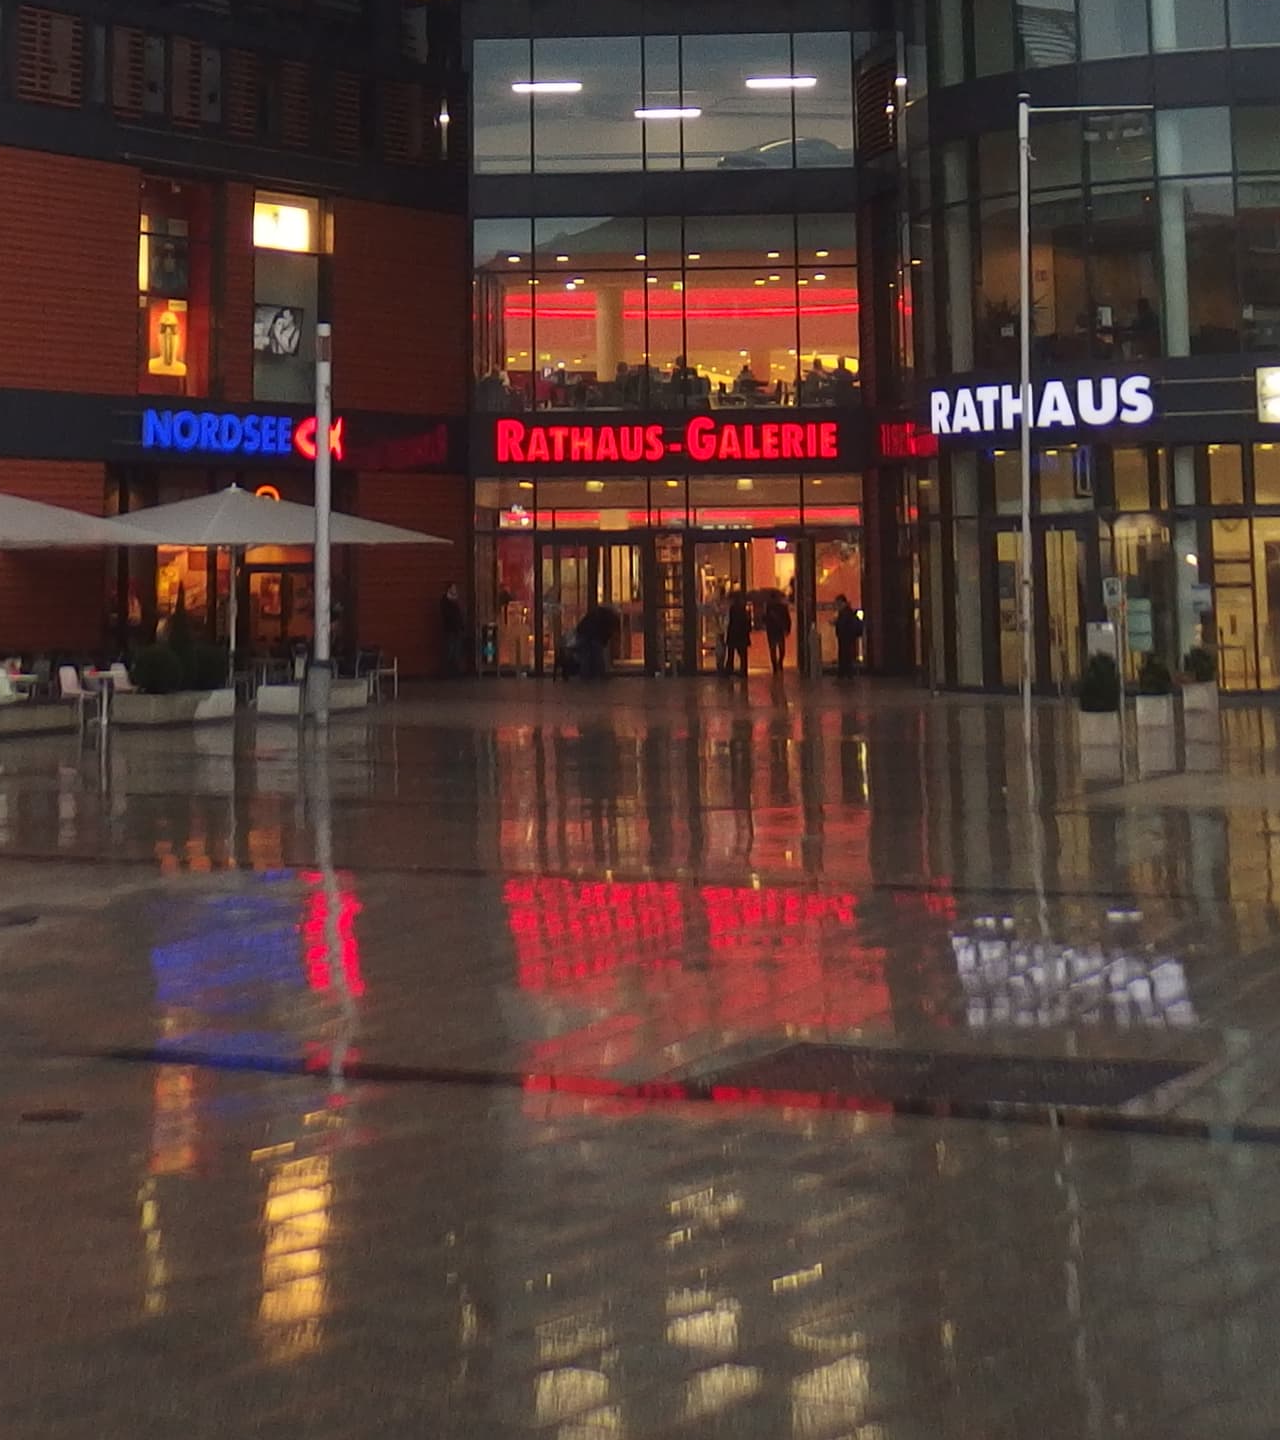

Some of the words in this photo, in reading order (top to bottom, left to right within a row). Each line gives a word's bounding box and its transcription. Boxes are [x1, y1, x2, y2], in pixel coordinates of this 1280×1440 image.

[930, 375, 1154, 435] RATHAUS
[141, 408, 292, 453] NORDSEE
[496, 416, 838, 462] RATHAUS-GALERIE
